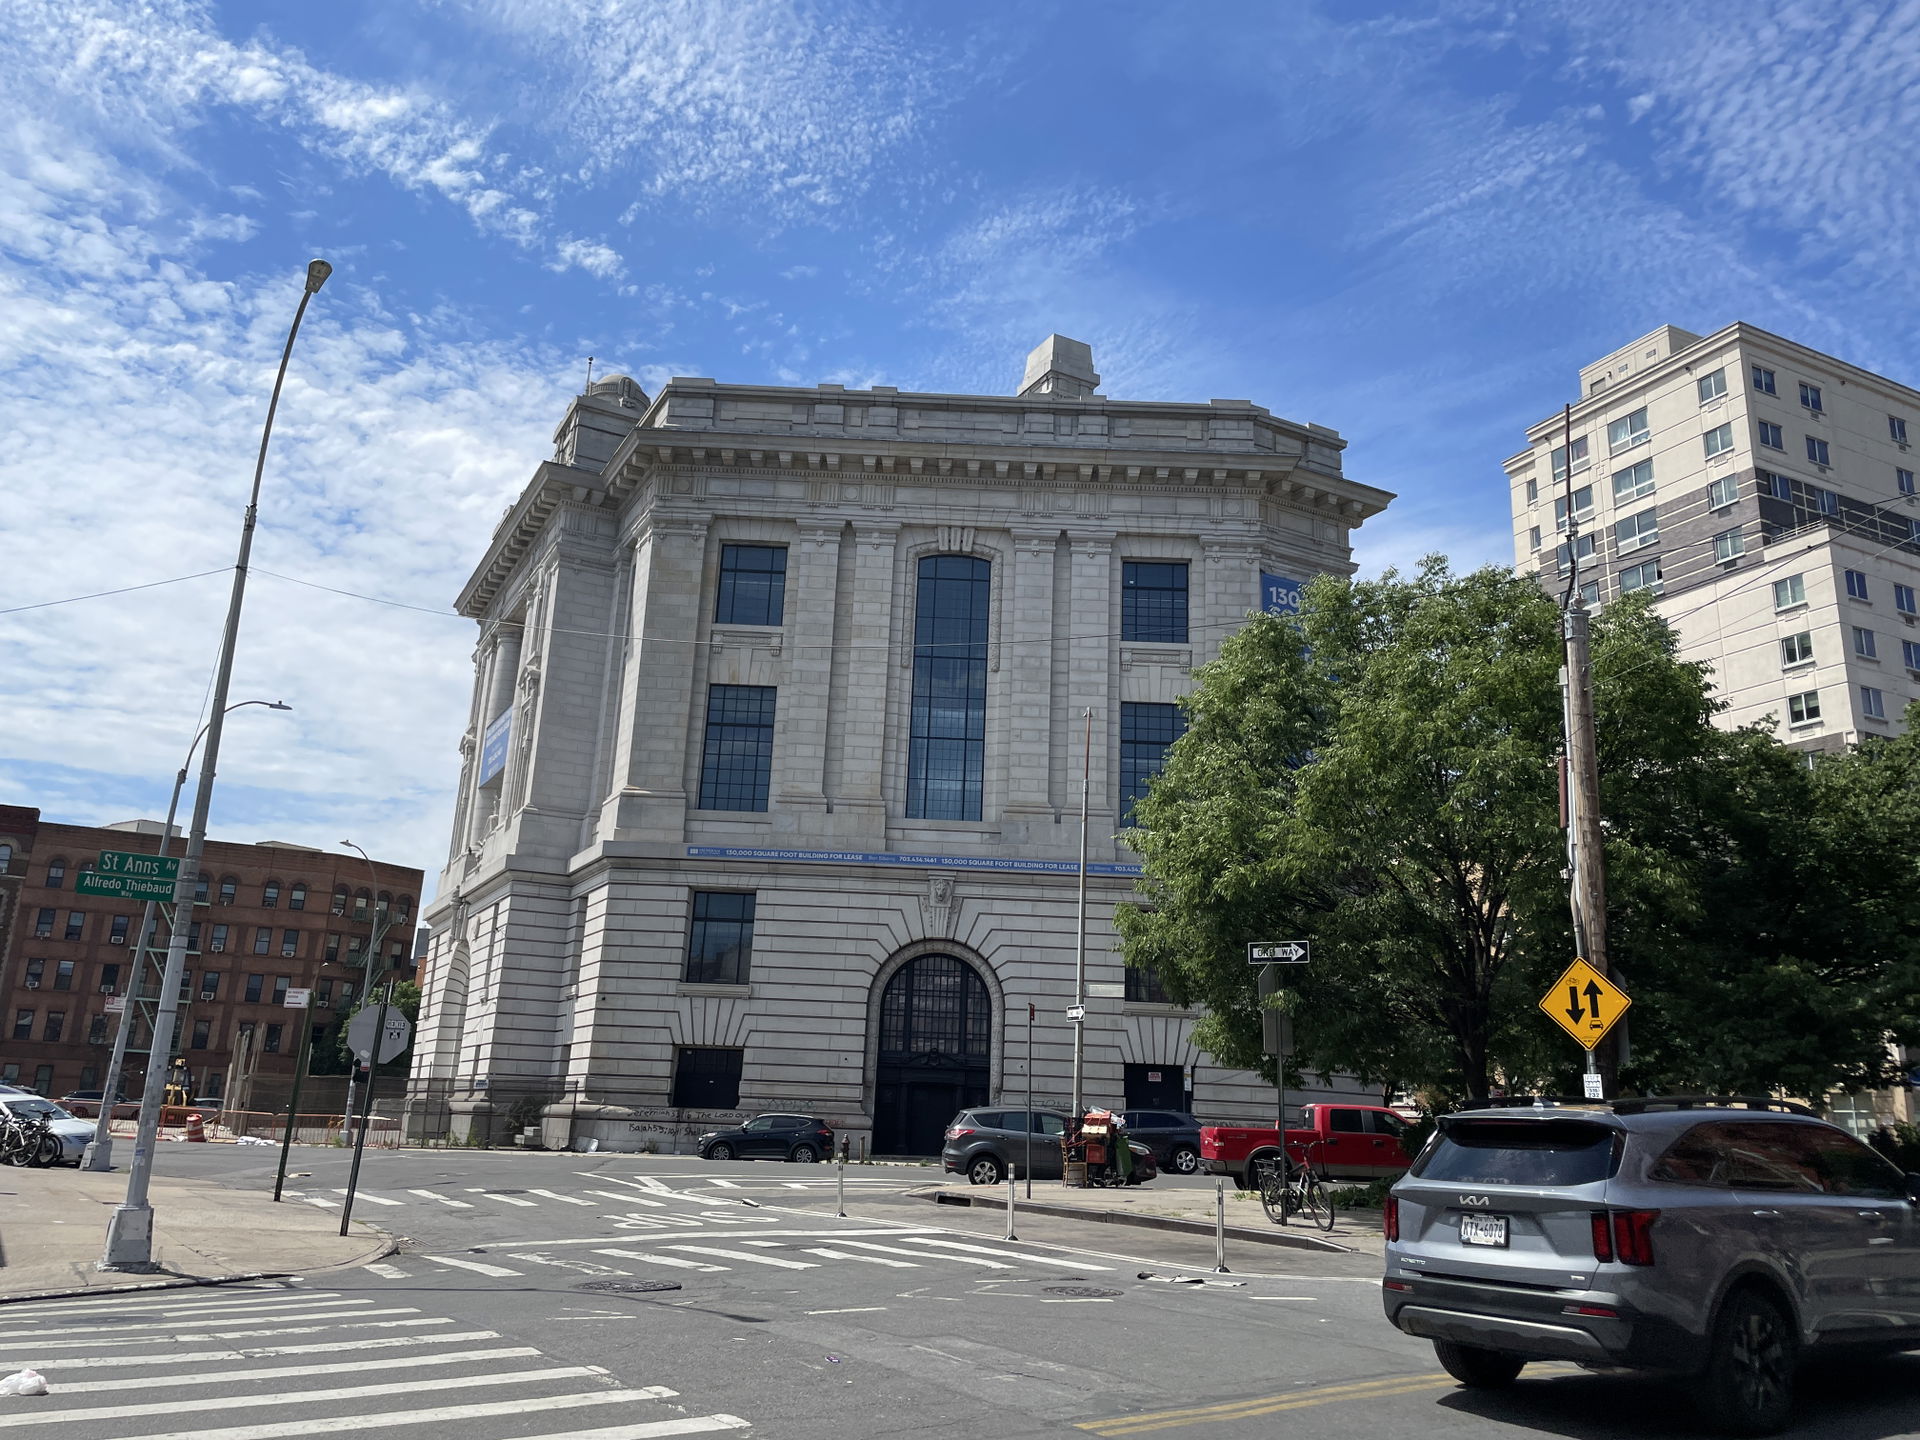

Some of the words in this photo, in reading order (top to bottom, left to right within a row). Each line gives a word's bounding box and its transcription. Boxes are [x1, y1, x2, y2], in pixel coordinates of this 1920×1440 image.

[103, 853, 119, 871] St
[125, 856, 159, 875] Anns
[166, 860, 177, 872] Av
[1013, 861, 1044, 869] BUILDING
[84, 875, 121, 891] Alfredo
[125, 879, 173, 895] Thiebaud
[1257, 947, 1275, 957] ONE
[1281, 947, 1299, 957] WAY
[1459, 1195, 1490, 1206] KIA
